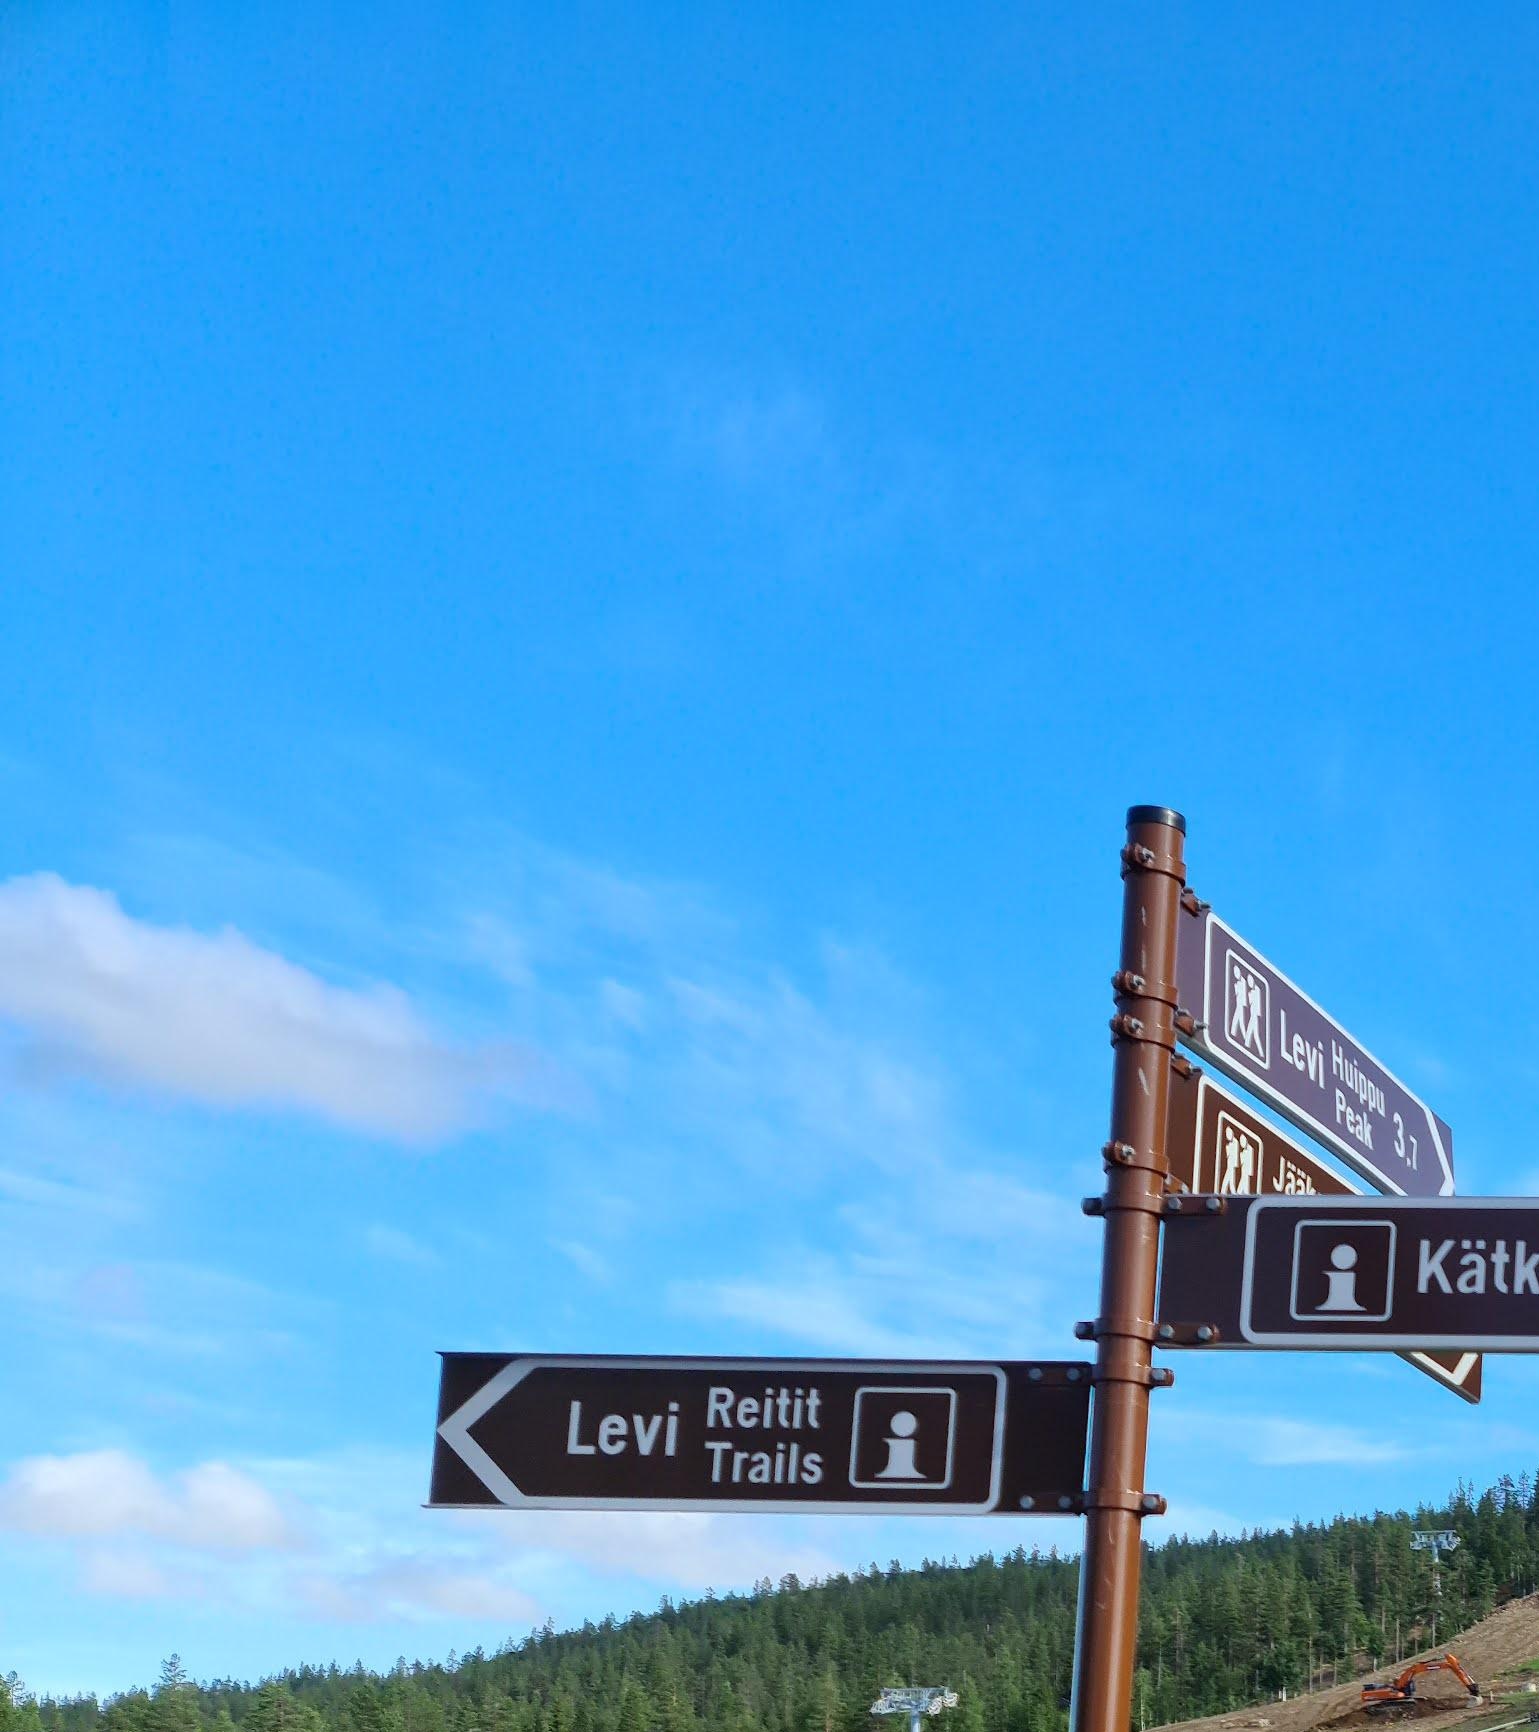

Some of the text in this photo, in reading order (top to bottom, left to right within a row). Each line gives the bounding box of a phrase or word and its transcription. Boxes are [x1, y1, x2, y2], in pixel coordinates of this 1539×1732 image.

[1280, 1008, 1385, 1118] Levi Huippu
[1335, 1088, 1374, 1150] Peak
[567, 1386, 821, 1457] Levi Reitit
[705, 1441, 824, 1485] Trails
